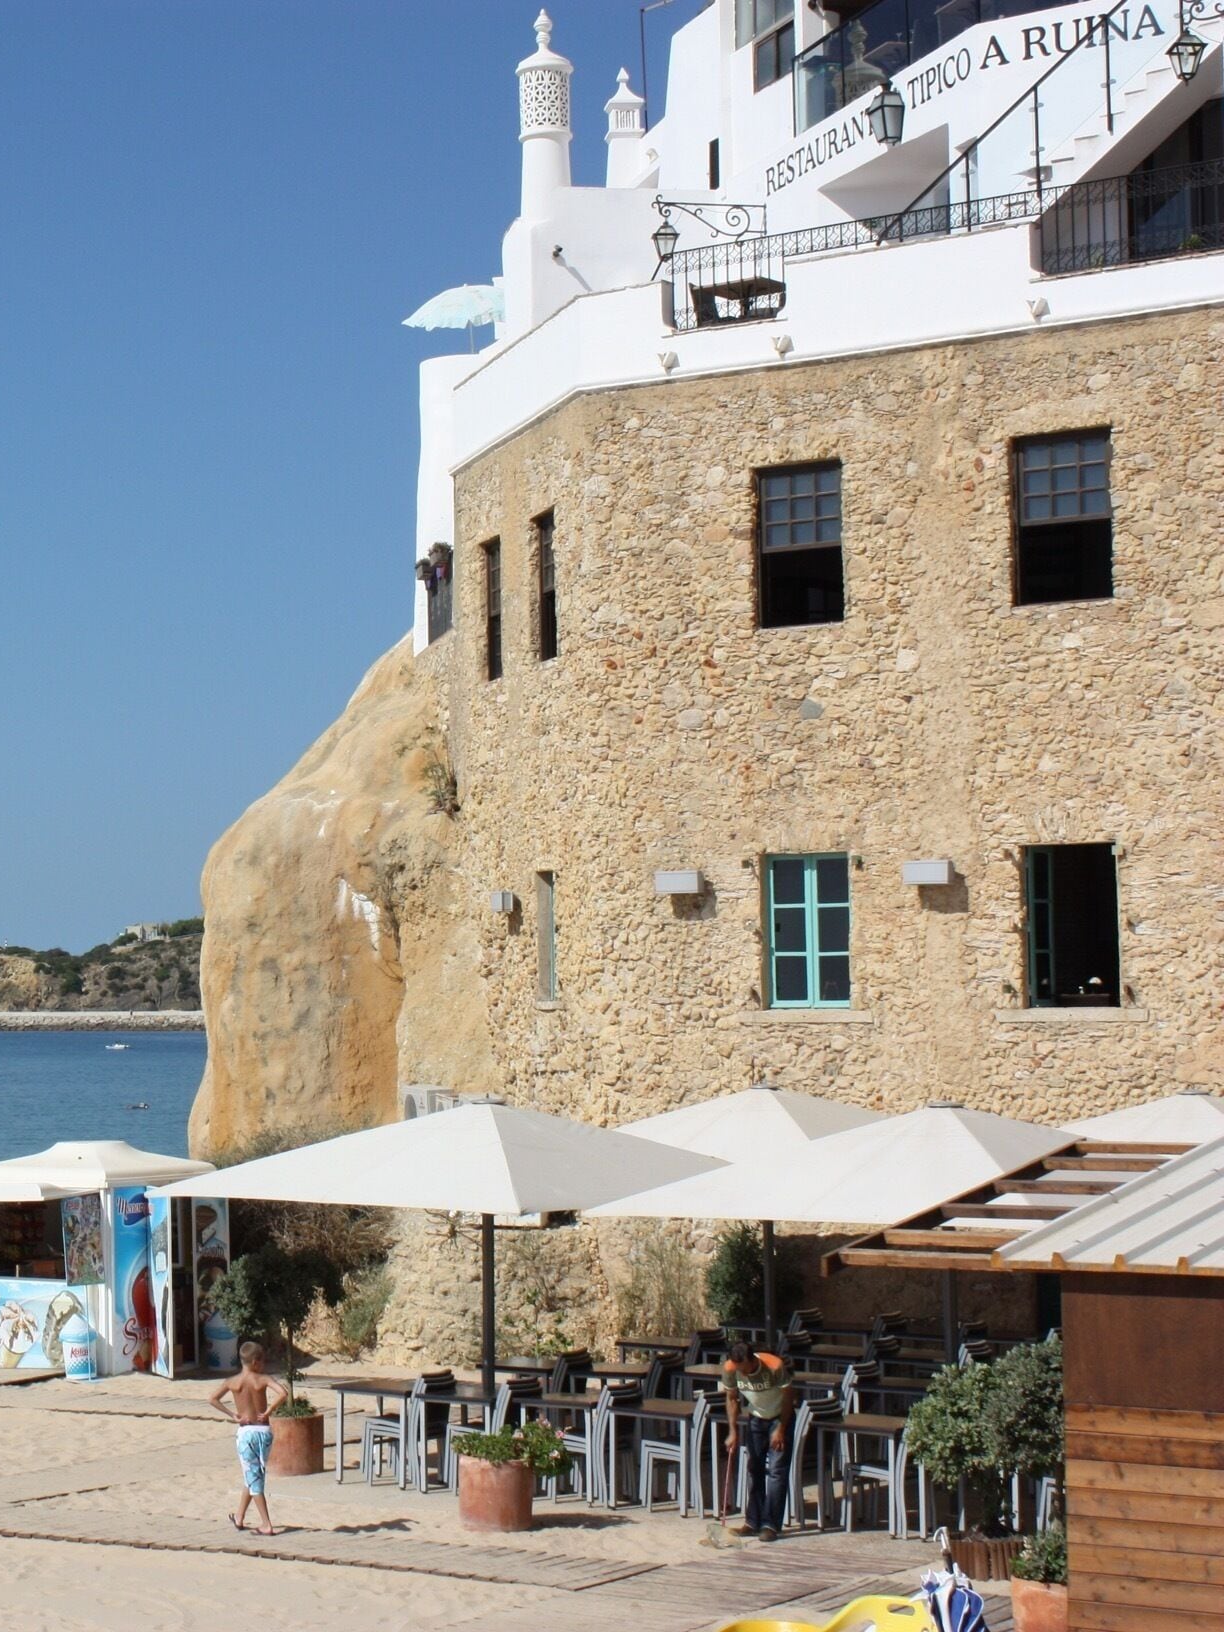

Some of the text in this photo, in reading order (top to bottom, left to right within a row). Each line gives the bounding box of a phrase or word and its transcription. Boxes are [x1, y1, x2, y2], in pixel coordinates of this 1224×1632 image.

[765, 4, 1165, 197] RESTAURANT TIPICO A RUINA
[737, 1380, 770, 1391] B-SIDE
